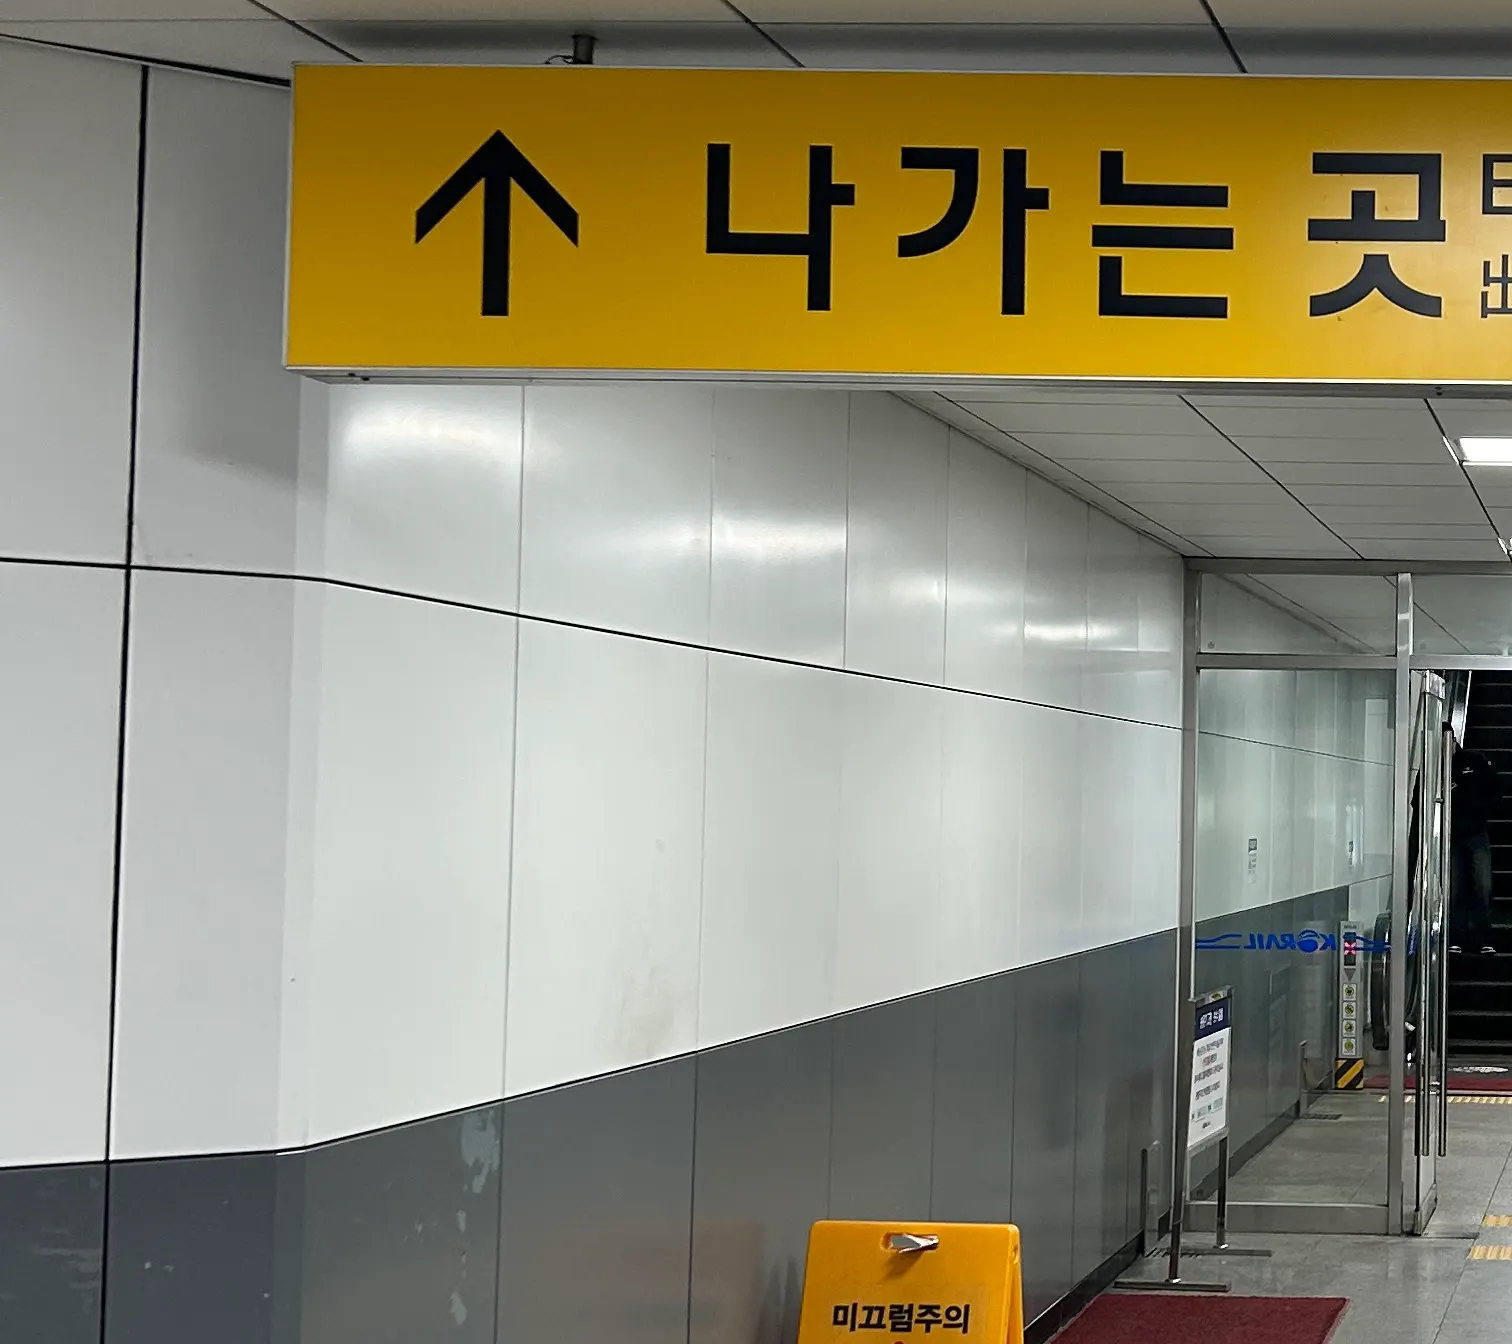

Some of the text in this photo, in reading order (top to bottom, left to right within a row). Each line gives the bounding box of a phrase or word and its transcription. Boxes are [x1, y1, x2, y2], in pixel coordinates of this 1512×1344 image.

[706, 143, 1446, 318] 나가는 곳
[832, 1302, 970, 1334] 미끄럼주의
